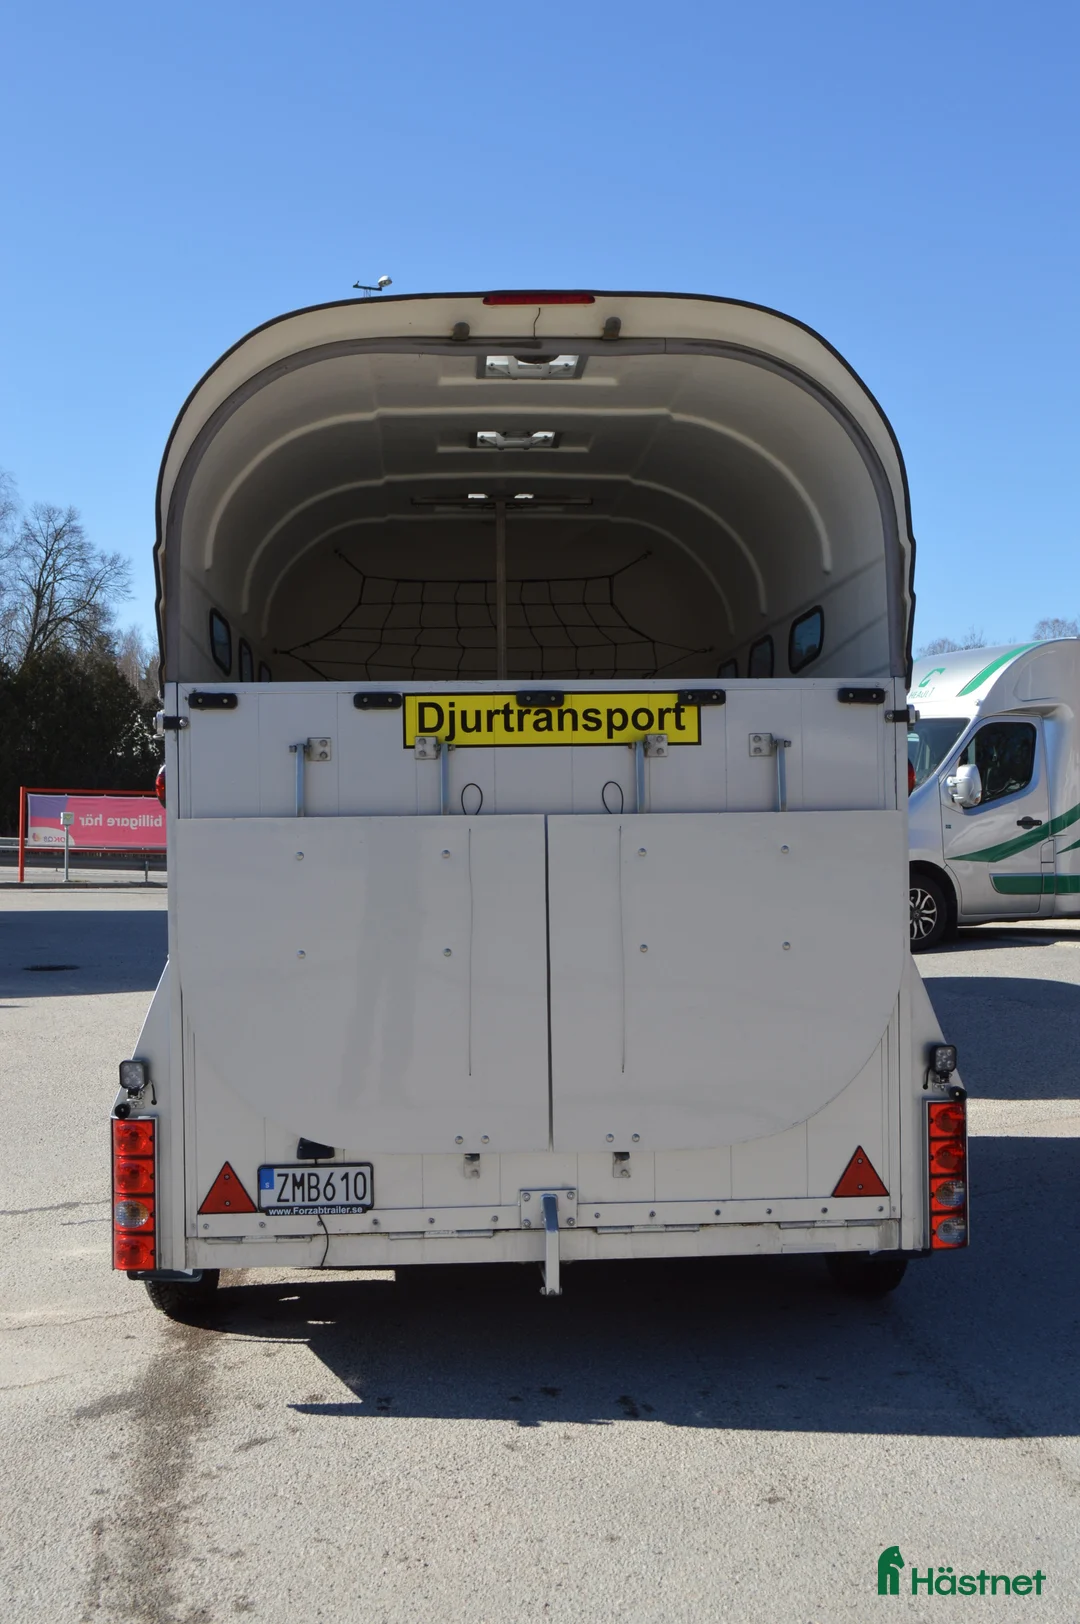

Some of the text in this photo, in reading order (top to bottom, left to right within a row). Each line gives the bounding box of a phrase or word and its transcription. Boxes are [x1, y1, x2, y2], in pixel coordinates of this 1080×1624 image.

[417, 701, 686, 741] Djurtransport
[276, 1171, 367, 1202] ZMB610
[268, 1205, 363, 1215] www.Forzabtrailer.se
